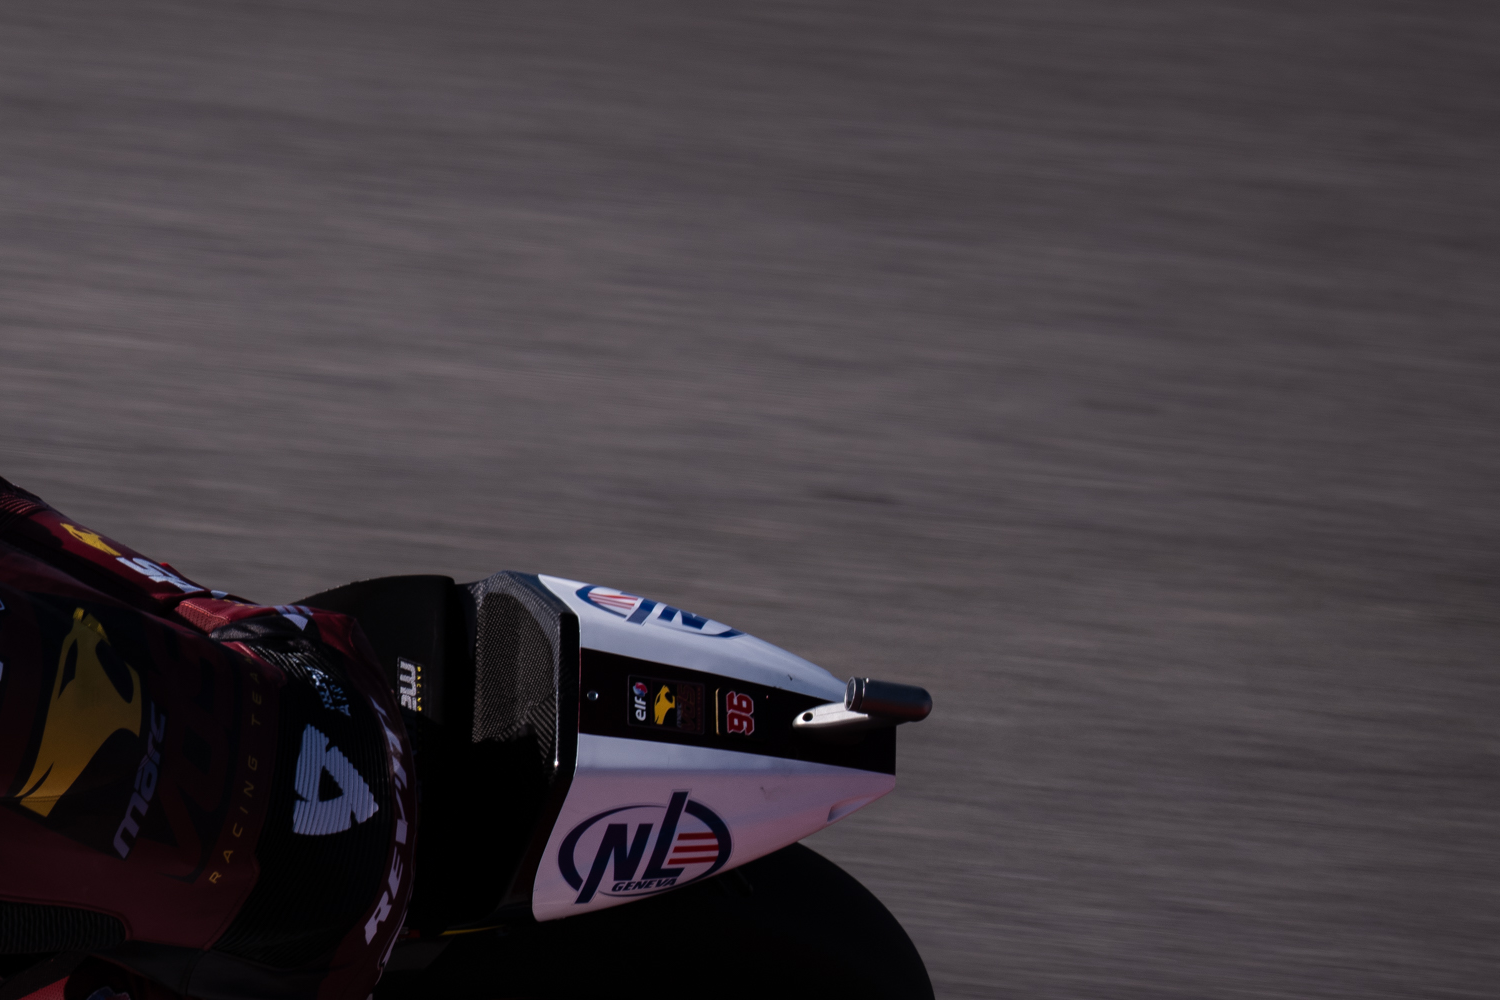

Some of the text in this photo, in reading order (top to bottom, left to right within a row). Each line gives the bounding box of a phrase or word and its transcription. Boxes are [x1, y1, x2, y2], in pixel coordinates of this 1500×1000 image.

[634, 695, 646, 722] elf
[726, 690, 755, 736] 96
[112, 701, 167, 860] marc
[209, 755, 258, 884] RACING
[574, 791, 689, 904] NL
[611, 878, 677, 892] GENEVA
